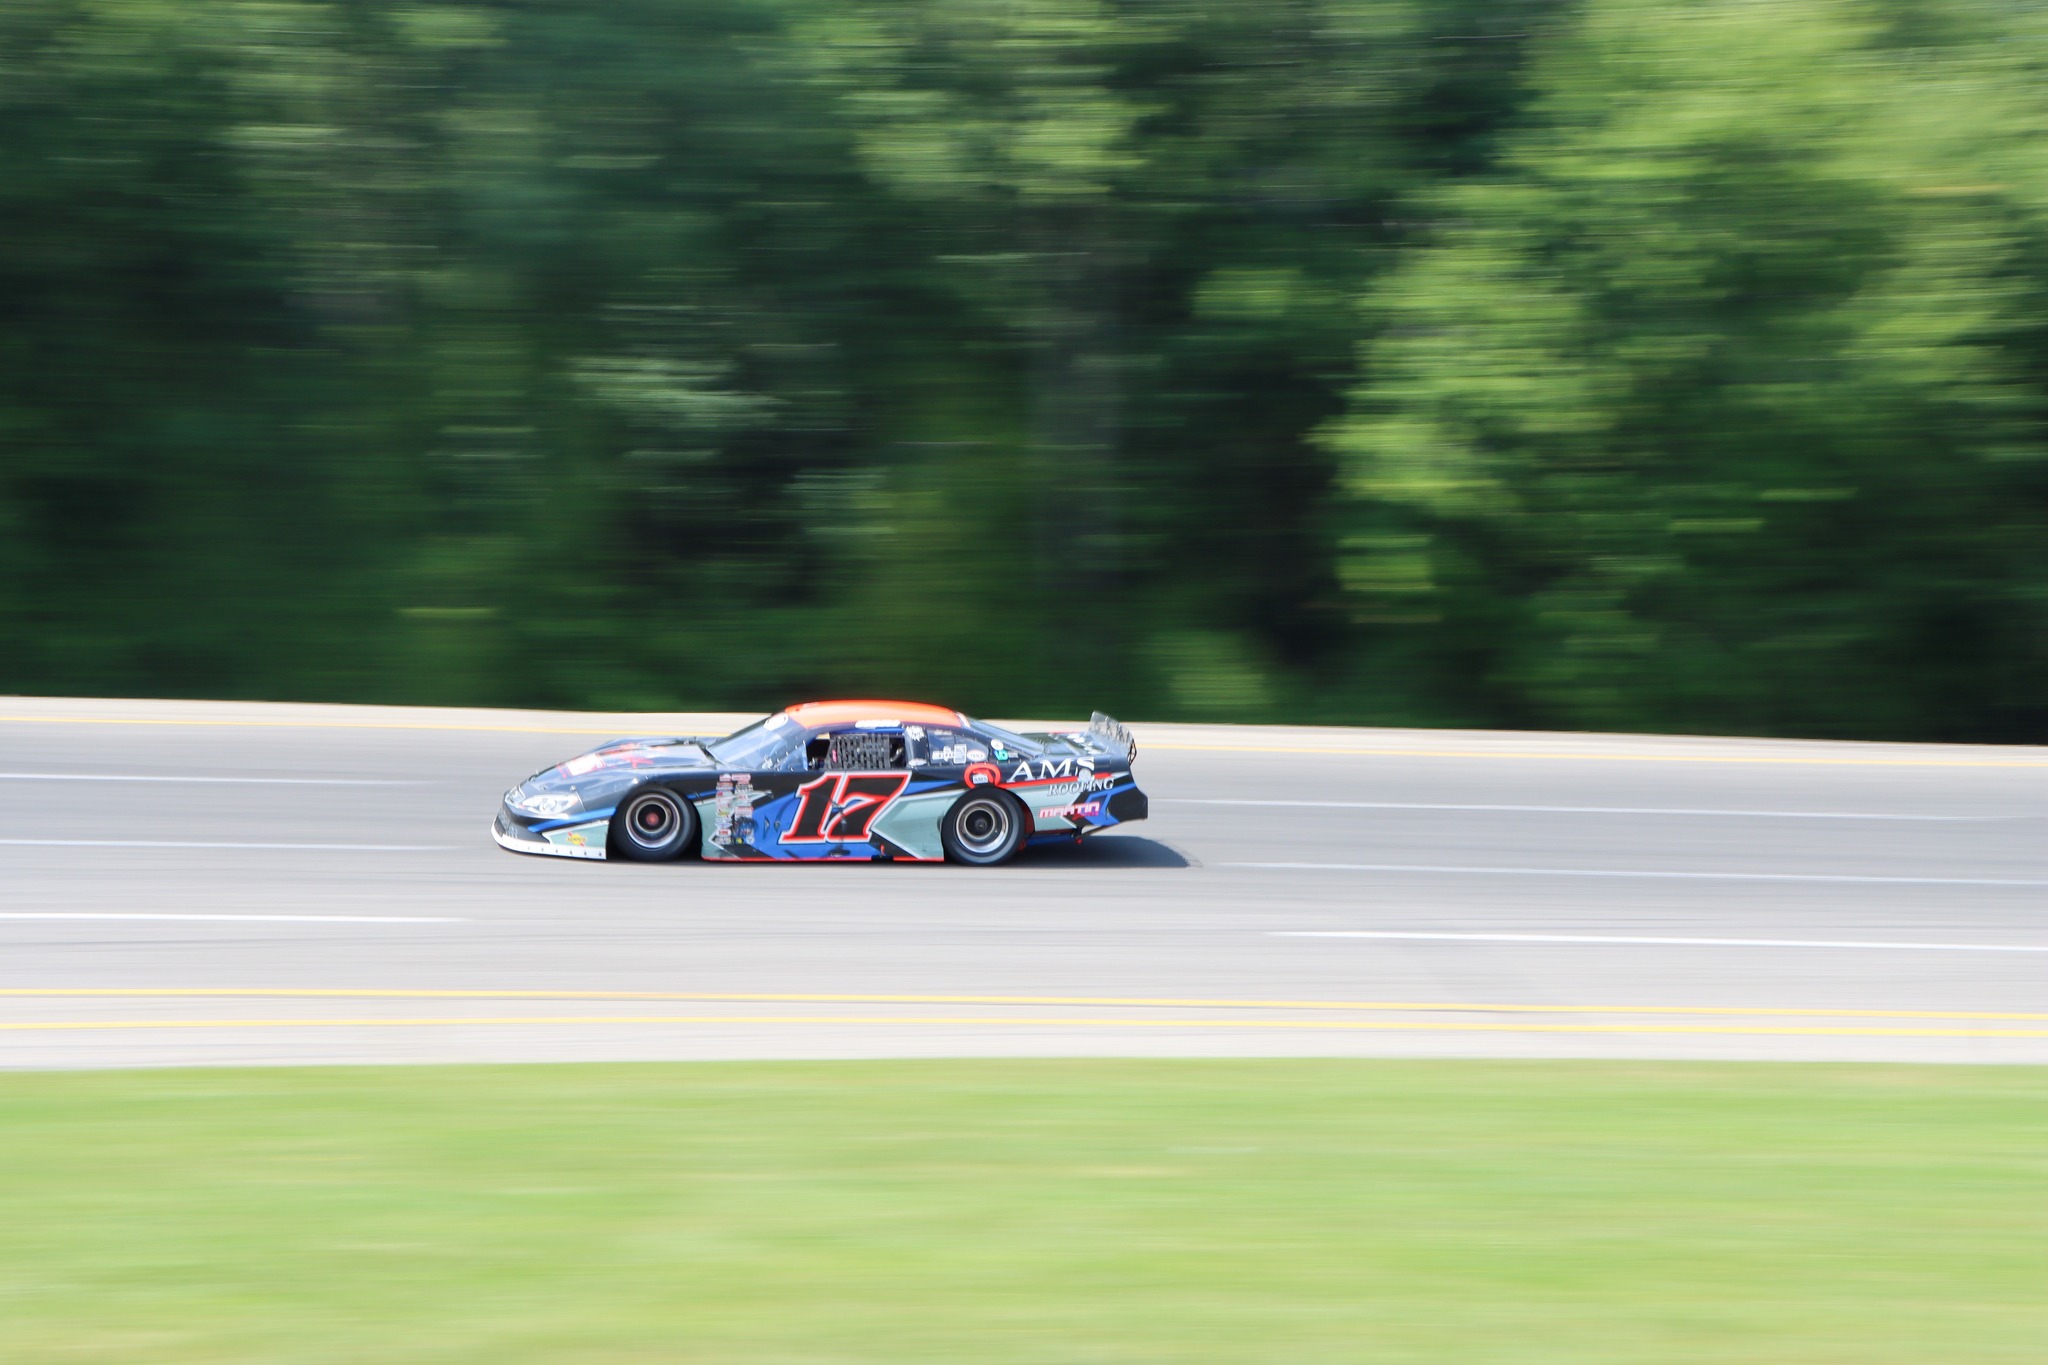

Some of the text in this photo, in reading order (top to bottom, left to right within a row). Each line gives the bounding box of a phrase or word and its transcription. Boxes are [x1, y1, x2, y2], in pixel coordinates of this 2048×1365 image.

[1006, 757, 1095, 783] AMS
[1048, 778, 1114, 797] ROOFING
[778, 771, 912, 844] 17
